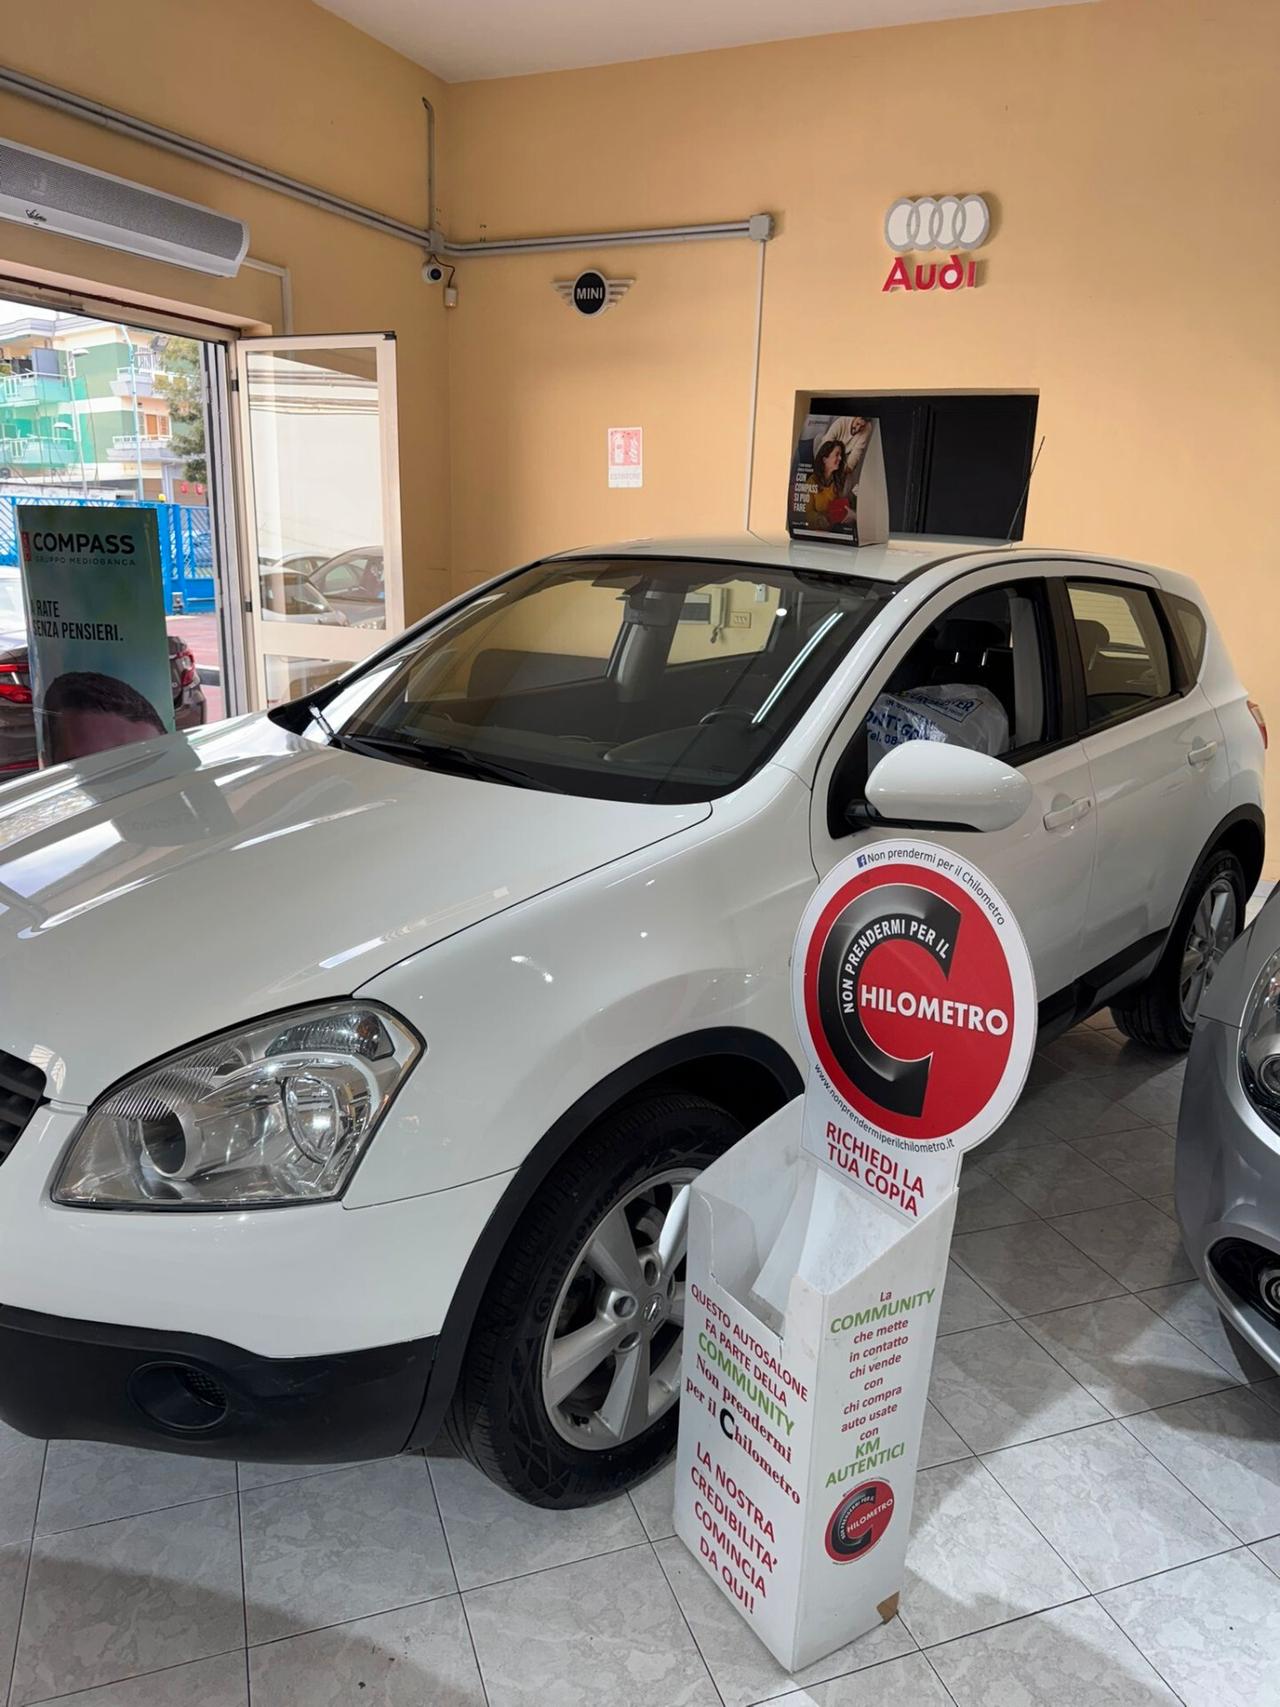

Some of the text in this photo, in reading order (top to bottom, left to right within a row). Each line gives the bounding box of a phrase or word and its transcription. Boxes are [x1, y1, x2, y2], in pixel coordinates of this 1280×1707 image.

[576, 286, 603, 300] MINI
[882, 255, 976, 292] Audi
[795, 482, 818, 493] COMPASS
[33, 532, 135, 555] COMPASS
[35, 556, 136, 566] GRUPPO MEDIOBANCA
[37, 600, 60, 618] RATE
[62, 622, 123, 642] PENSIERI.
[867, 848, 1005, 926] Non prendermi per il Chilometro
[843, 919, 949, 1014] NON PRENDERMI PER IL
[815, 1064, 955, 1153] www.nonprendermiperilchilometro.it
[826, 1122, 923, 1198] RICHIEDI LA
[827, 1142, 918, 1216] TUA COPIA
[830, 1288, 936, 1334] COMMUNITY
[879, 1290, 892, 1303] La
[691, 1284, 808, 1402] QUESTO AUTOSALONE
[849, 1335, 909, 1363] in contatto
[853, 1319, 909, 1345] che mette
[705, 1318, 788, 1407] FA PARTE DELLA
[849, 1354, 902, 1380] chi vende
[698, 1332, 794, 1436] COMMUNITY
[843, 1385, 902, 1415] chi compra
[864, 1377, 884, 1391] con
[696, 1353, 792, 1463] Non prendermi
[841, 1403, 898, 1433] auto usate
[686, 1377, 801, 1505] per il Chilometro
[855, 1437, 881, 1459] KM
[859, 1426, 879, 1441] con
[825, 1442, 905, 1488] AUTENTICI
[696, 1442, 776, 1543] LA NOSTRA
[691, 1466, 778, 1573] CREDIBILITA'
[695, 1501, 767, 1598] COMINCIA
[700, 1537, 754, 1615] DA QUI!
